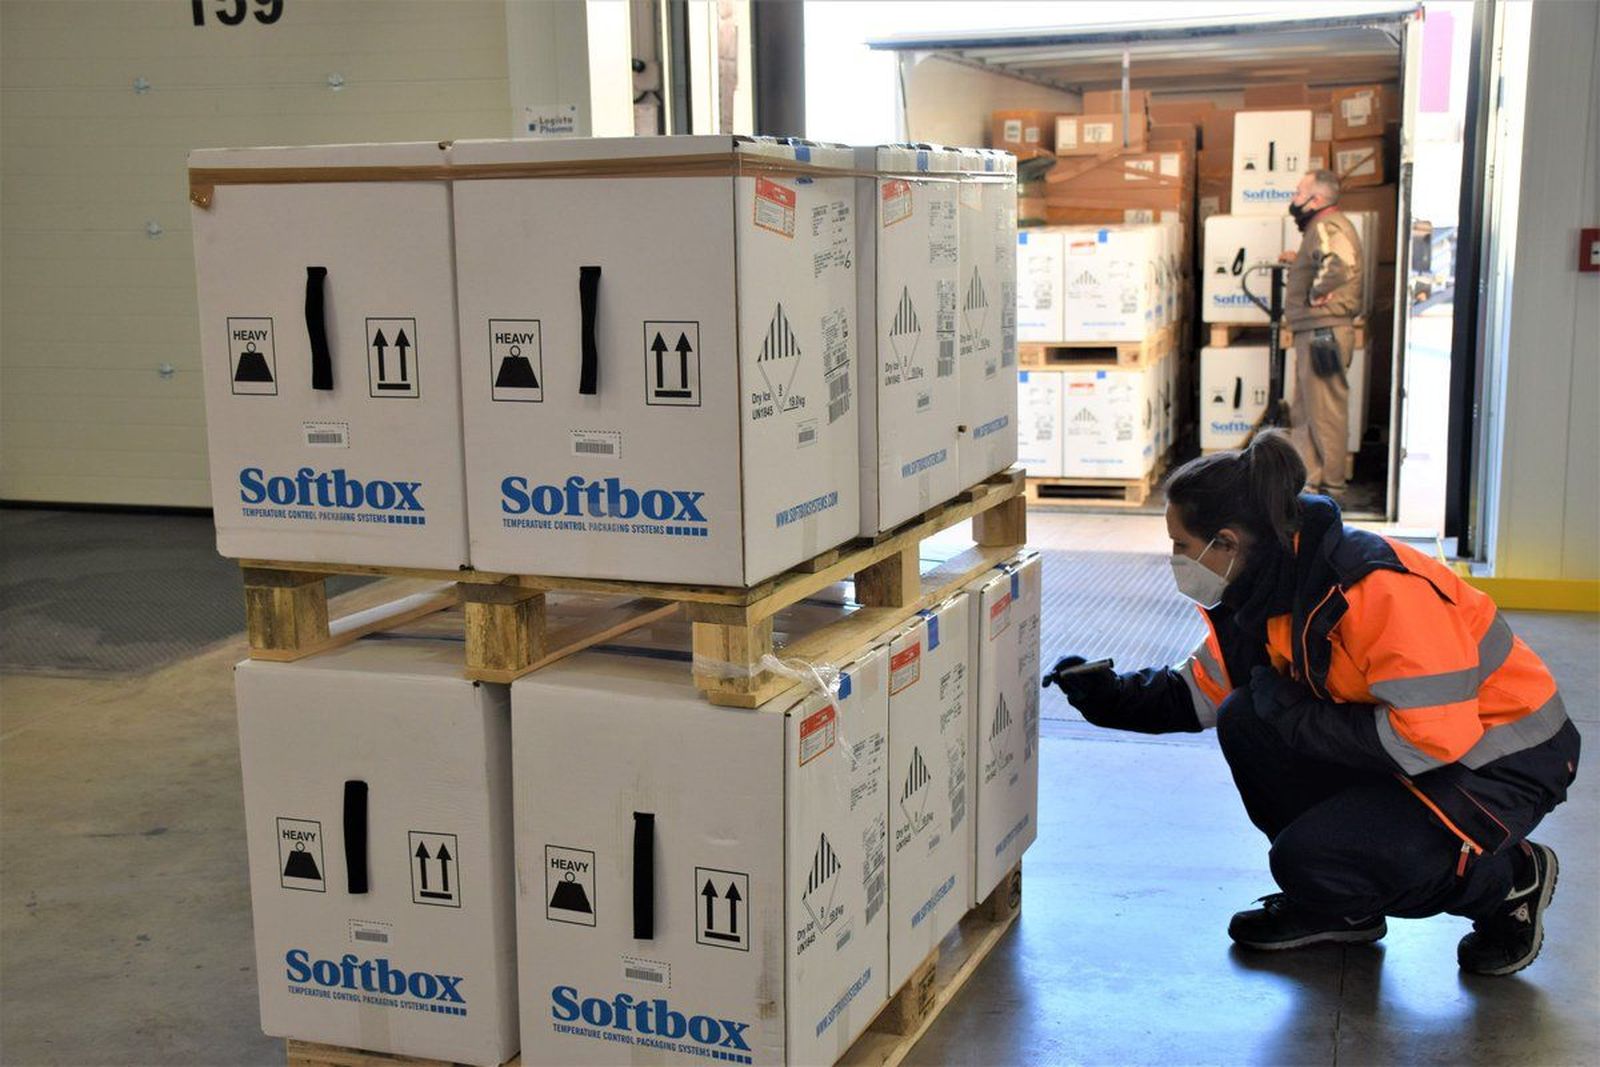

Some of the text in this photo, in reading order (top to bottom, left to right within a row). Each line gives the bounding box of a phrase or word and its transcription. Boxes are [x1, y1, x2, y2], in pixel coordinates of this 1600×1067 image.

[233, 330, 268, 341] HEAVY
[495, 333, 534, 344] HEAVY
[239, 467, 425, 511] Softbox
[501, 476, 708, 522] Softbox
[242, 507, 387, 523] TEMPERATURE CONTROL PACKAGING SYSTEMS
[502, 518, 665, 535] TEMPERATURE CONTROL PACKAGING SYSTEMS
[282, 829, 316, 842] HEAVY
[551, 858, 589, 872] HEAVY
[285, 949, 467, 1004] Softbox
[288, 985, 430, 1012] TEMPERATURE CONTROL PACKAGING SYSTEMS
[551, 985, 752, 1052] Softbox
[553, 1023, 711, 1058] TEMPERATURE CONTROL PACKAGING SYSTEMS
